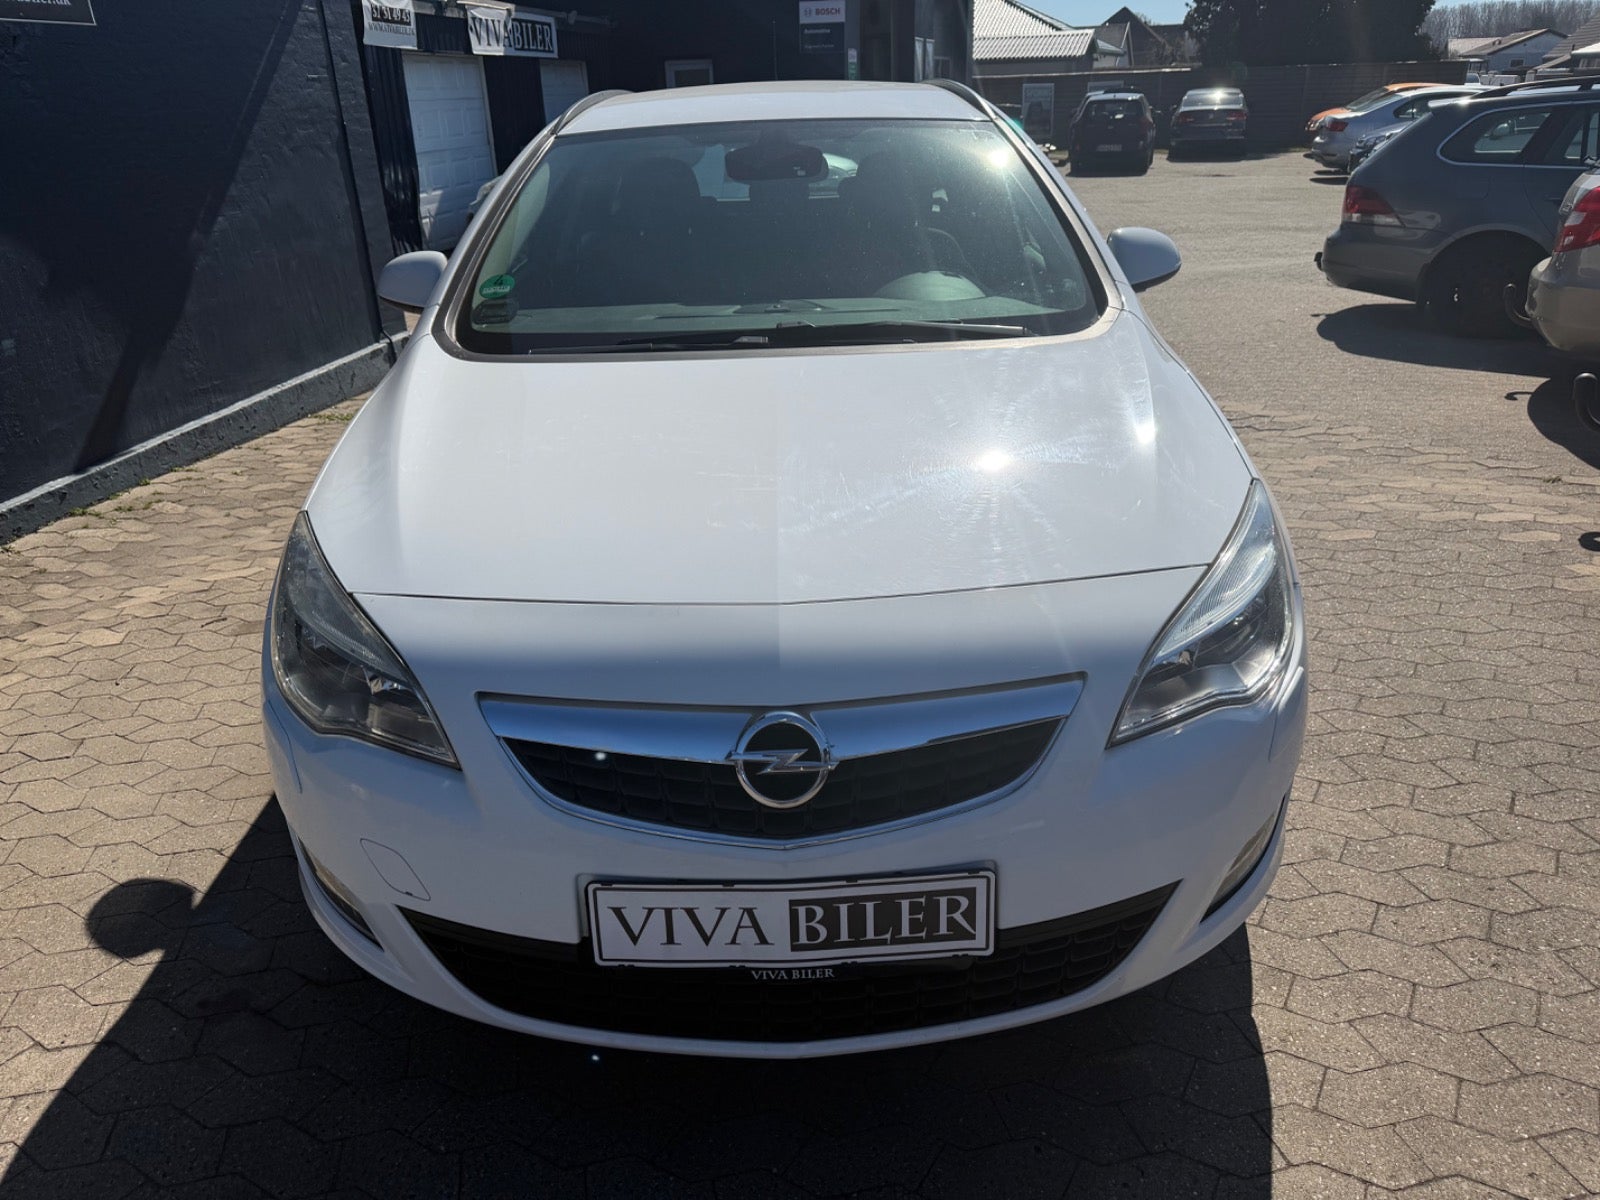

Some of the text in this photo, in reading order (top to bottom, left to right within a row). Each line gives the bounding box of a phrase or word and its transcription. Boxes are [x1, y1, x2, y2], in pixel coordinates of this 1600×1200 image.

[816, 8, 840, 16] BOSCH
[471, 17, 553, 51] VIVA BILER
[607, 895, 976, 946] VIVA BILER
[751, 968, 836, 980] VIVA BILER
